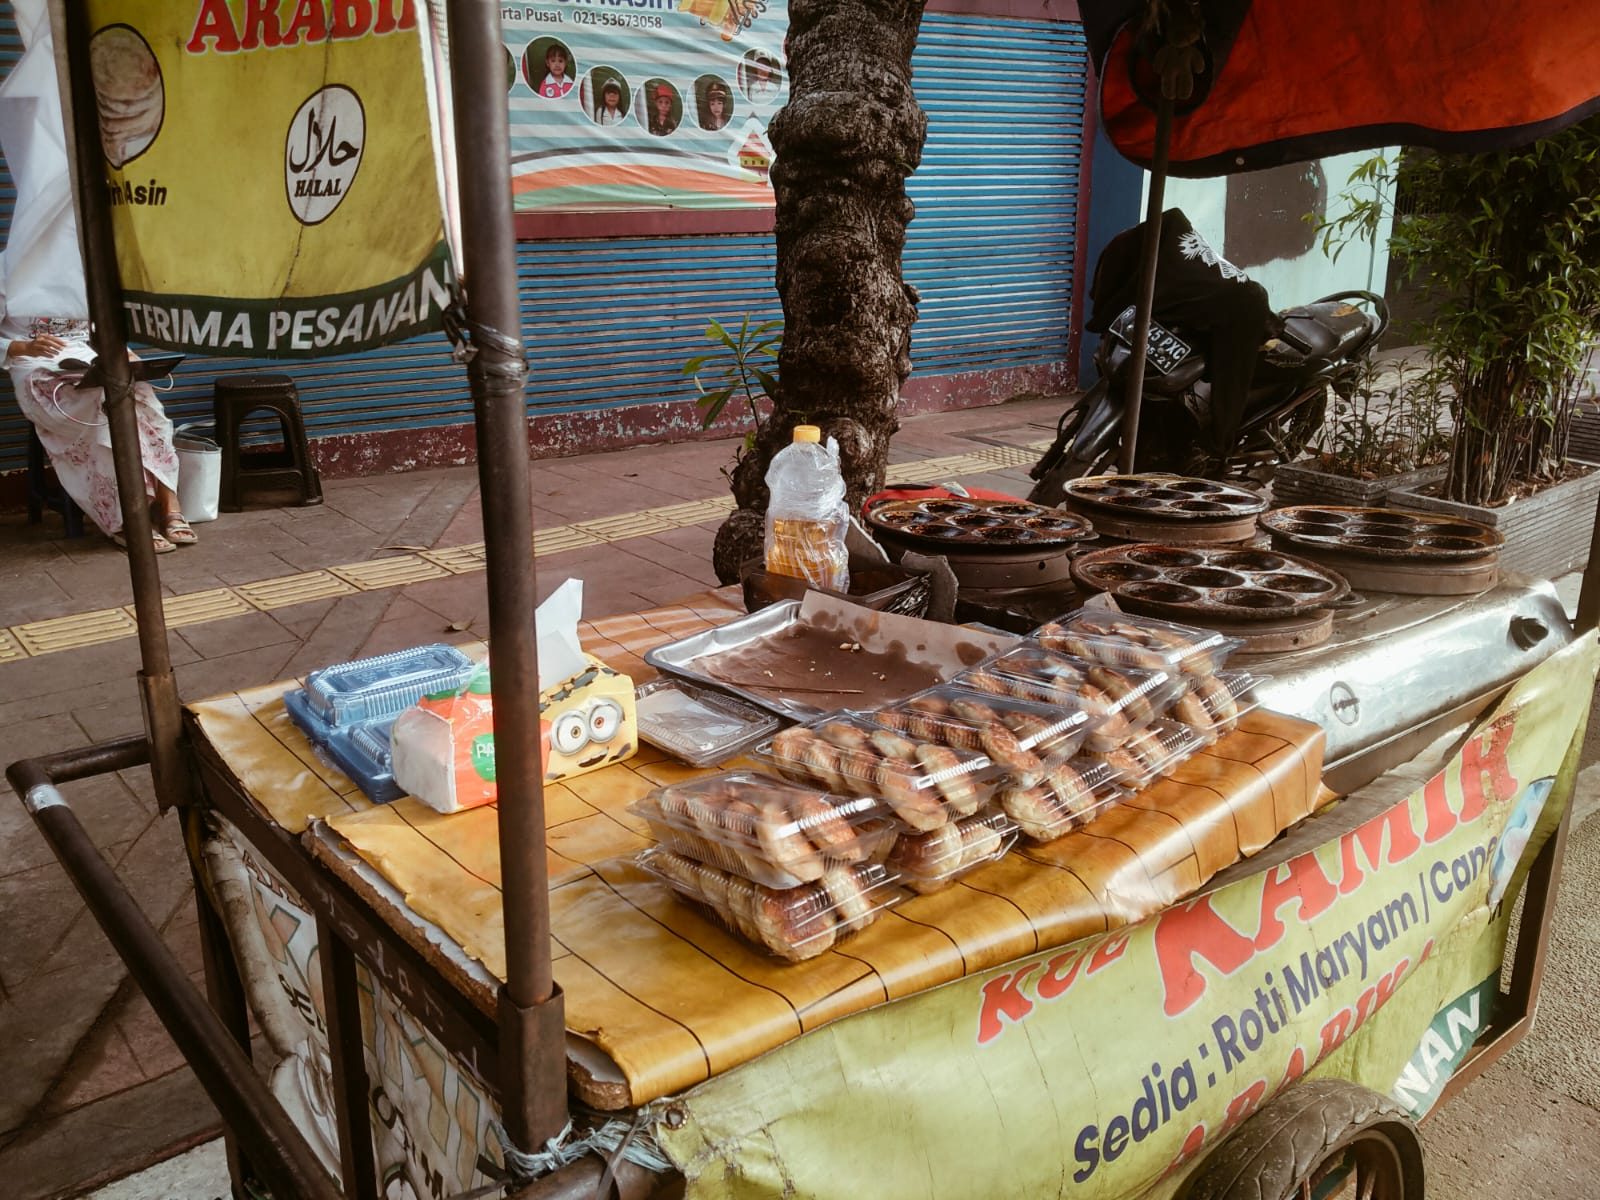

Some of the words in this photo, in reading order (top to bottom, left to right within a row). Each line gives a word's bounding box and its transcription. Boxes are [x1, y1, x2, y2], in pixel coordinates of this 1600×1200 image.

[526, 8, 563, 23] Pusat
[573, 11, 663, 29] 021-53673058
[125, 179, 167, 206] Asin
[294, 178, 342, 198] HALAL
[123, 301, 254, 350] TERIMA
[267, 259, 451, 351] PESANAN
[1159, 337, 1186, 360] PXC
[1211, 972, 1288, 1074] Roti
[1283, 892, 1419, 1016] Maryam
